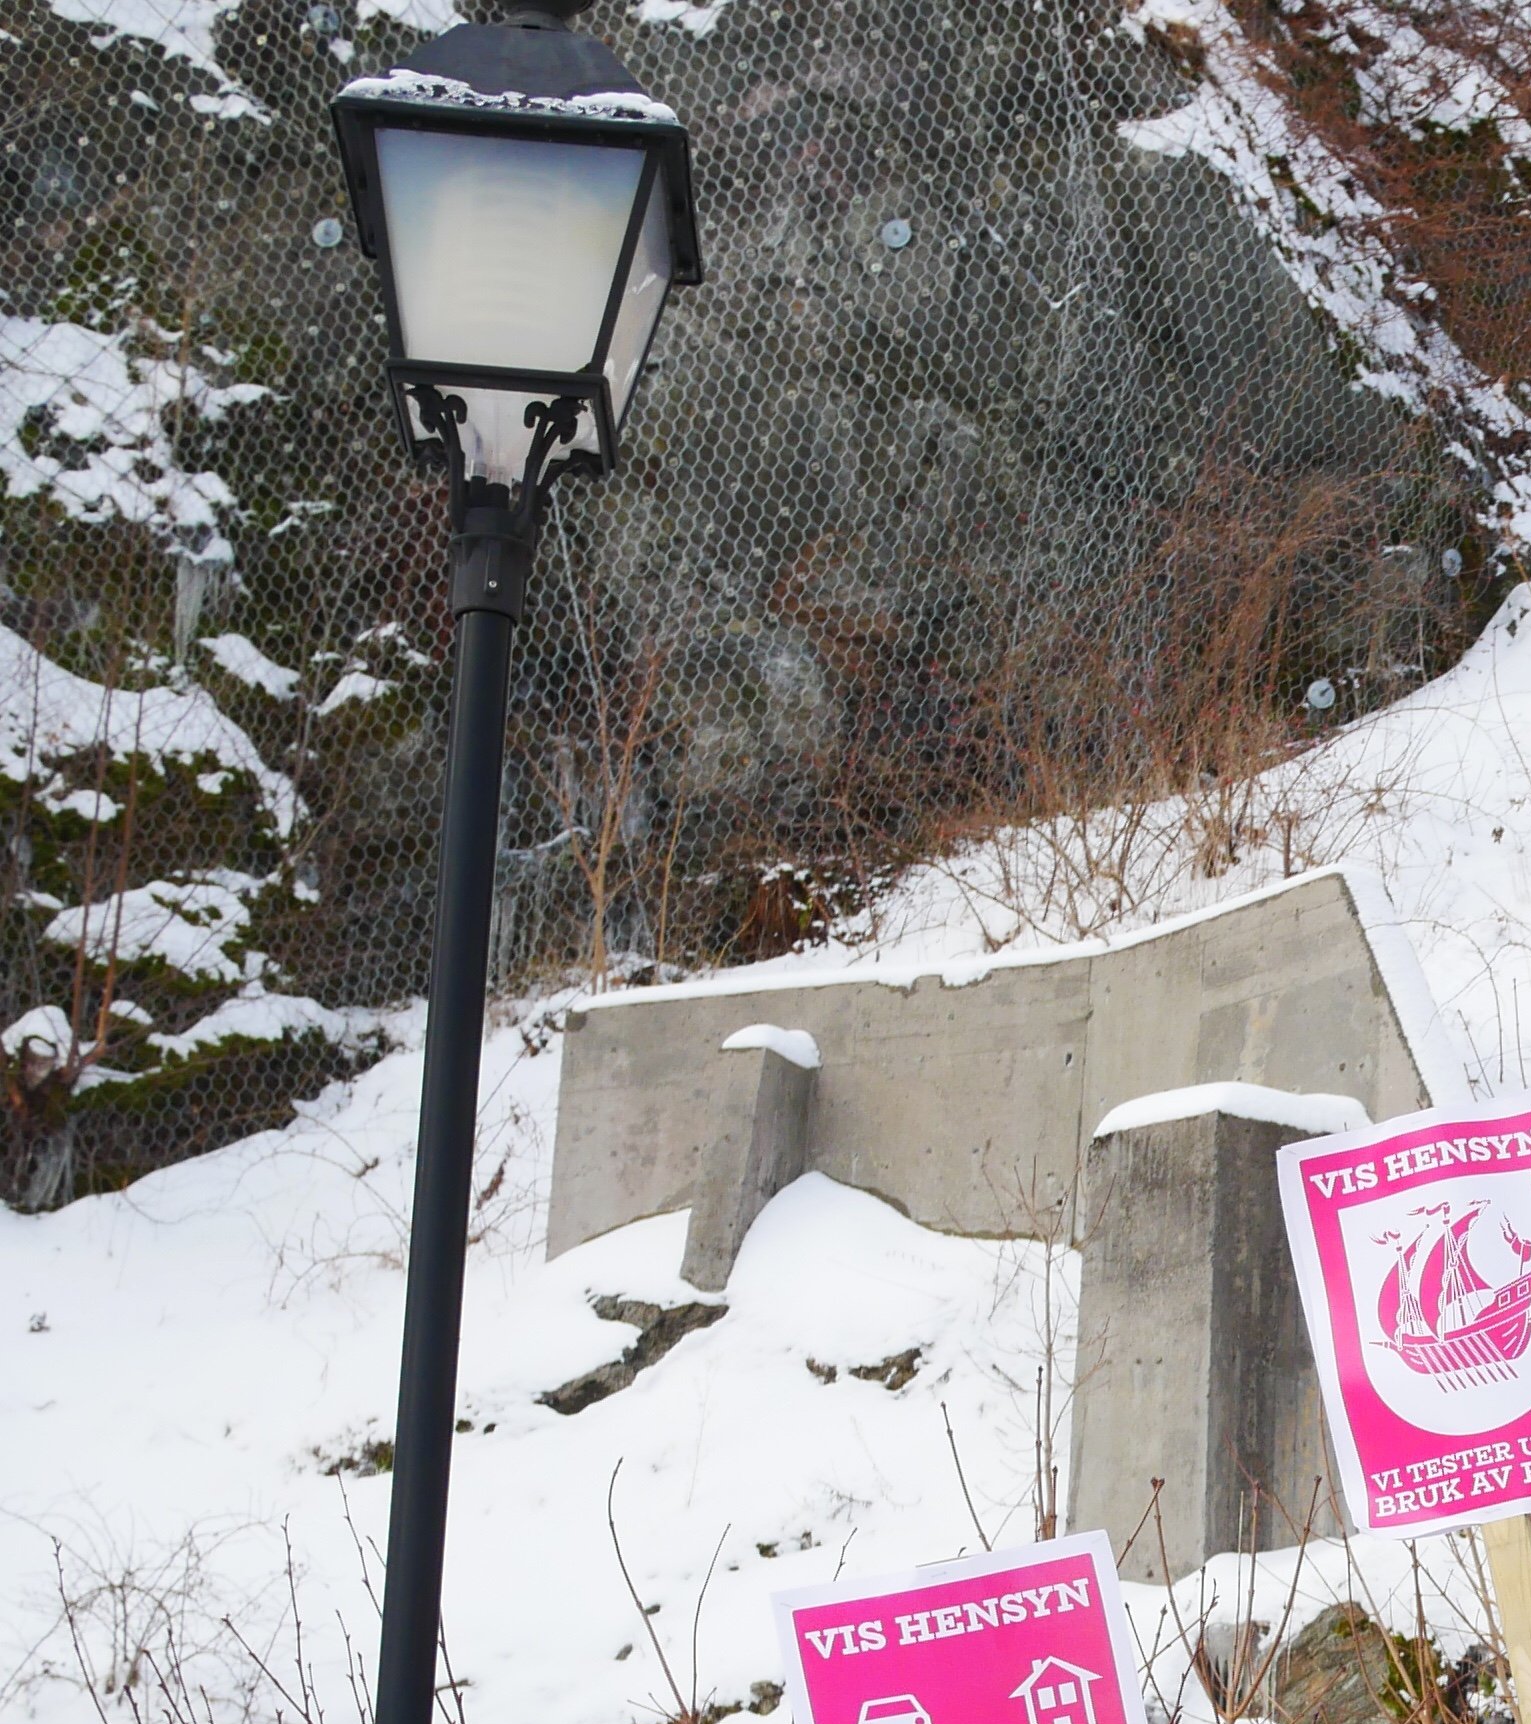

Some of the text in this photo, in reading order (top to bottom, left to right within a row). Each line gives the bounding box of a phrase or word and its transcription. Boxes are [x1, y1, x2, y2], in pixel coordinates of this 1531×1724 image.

[1310, 1162, 1378, 1198] VIS
[1371, 1469, 1403, 1491] VI
[1406, 1442, 1514, 1482] TESTER
[1374, 1478, 1464, 1518] BRUK
[1470, 1465, 1512, 1496] AV
[805, 1578, 1090, 1659] VIS HENSYN
